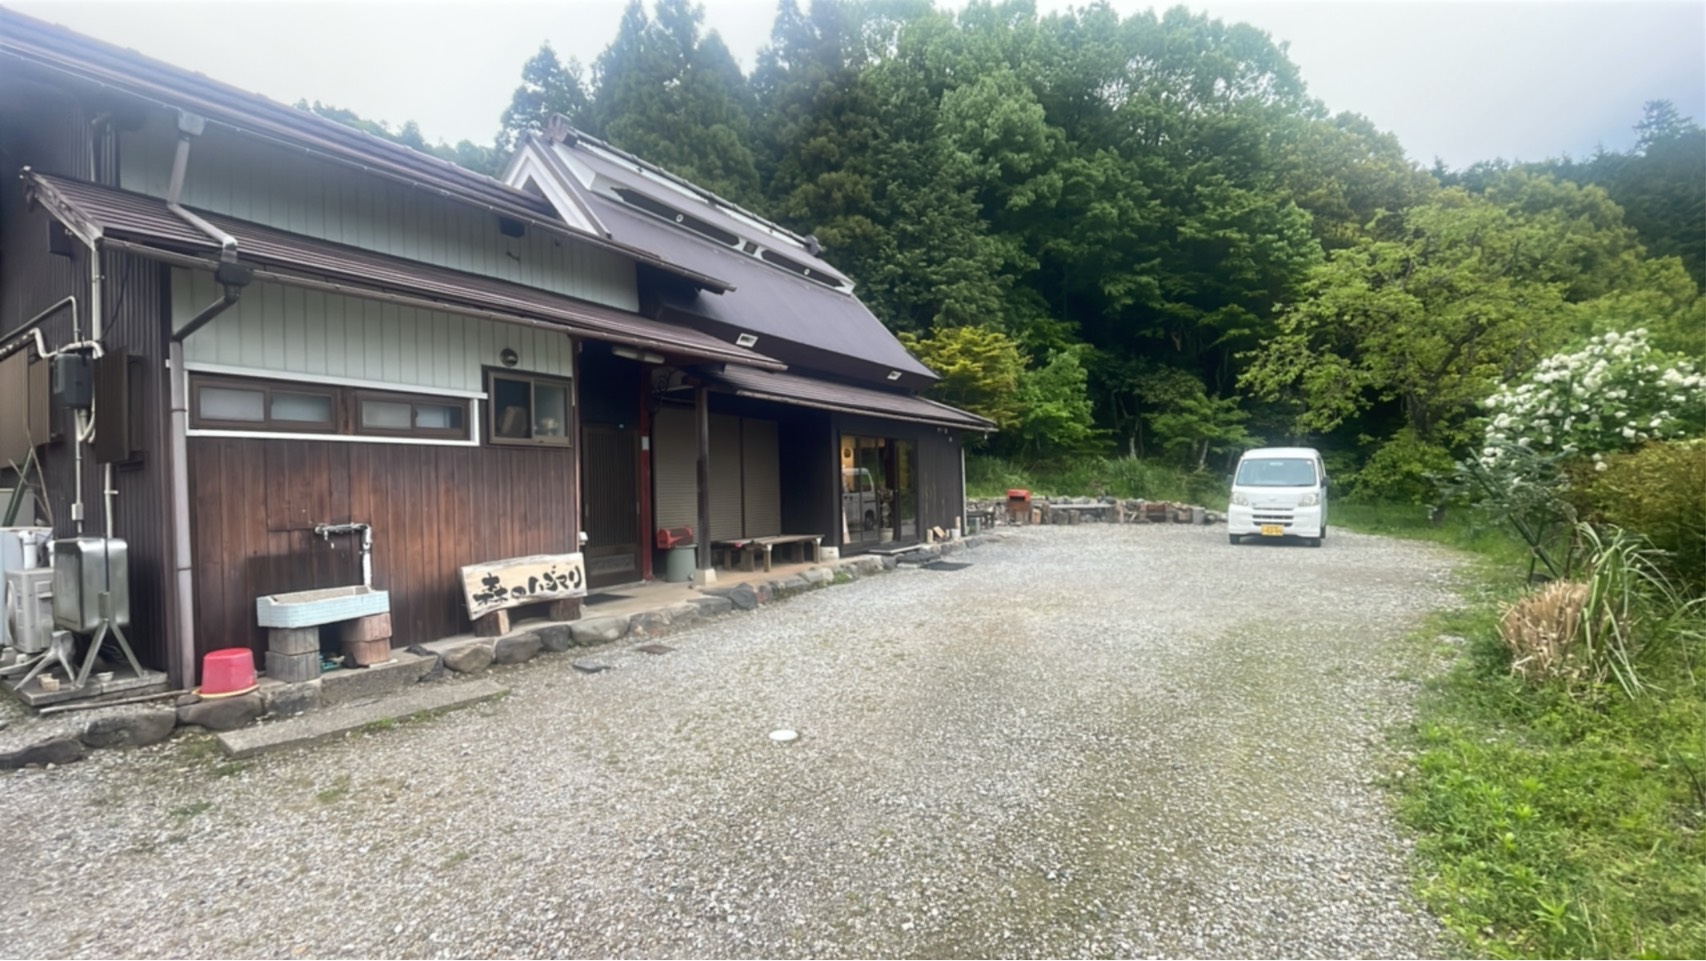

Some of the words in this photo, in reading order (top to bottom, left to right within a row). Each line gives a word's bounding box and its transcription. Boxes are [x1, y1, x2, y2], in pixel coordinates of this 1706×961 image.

[473, 565, 582, 606] 森のハジマリ
